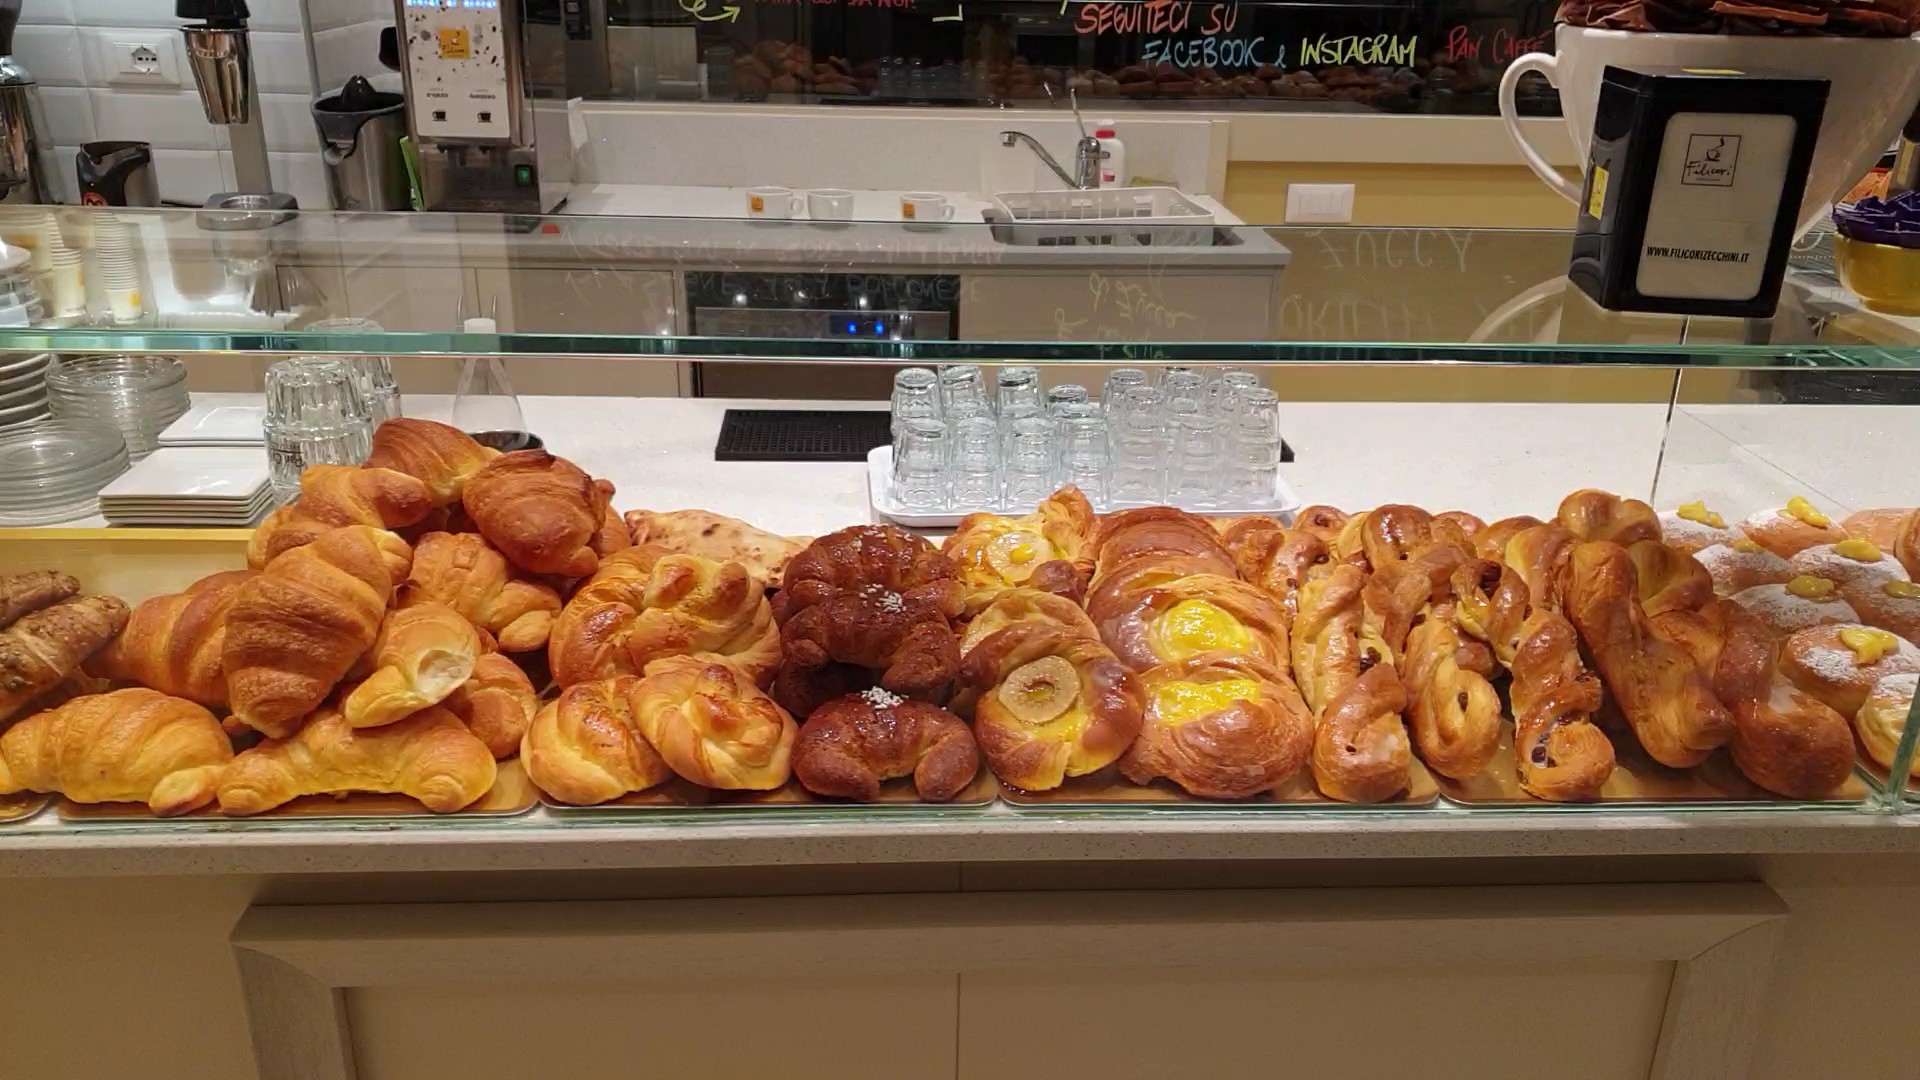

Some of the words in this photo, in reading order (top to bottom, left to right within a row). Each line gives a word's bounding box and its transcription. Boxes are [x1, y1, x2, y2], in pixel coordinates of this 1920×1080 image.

[1074, 1, 1193, 35] SEGUITECI
[1200, 2, 1238, 35] SU
[1141, 36, 1265, 69] FACEBOOK
[1300, 32, 1418, 68] INSTAGRAM
[1446, 25, 1483, 61] PAN
[1687, 160, 1733, 177] Filicori
[1647, 246, 1750, 263] WWW.FILICORIZECCHINI.IT
